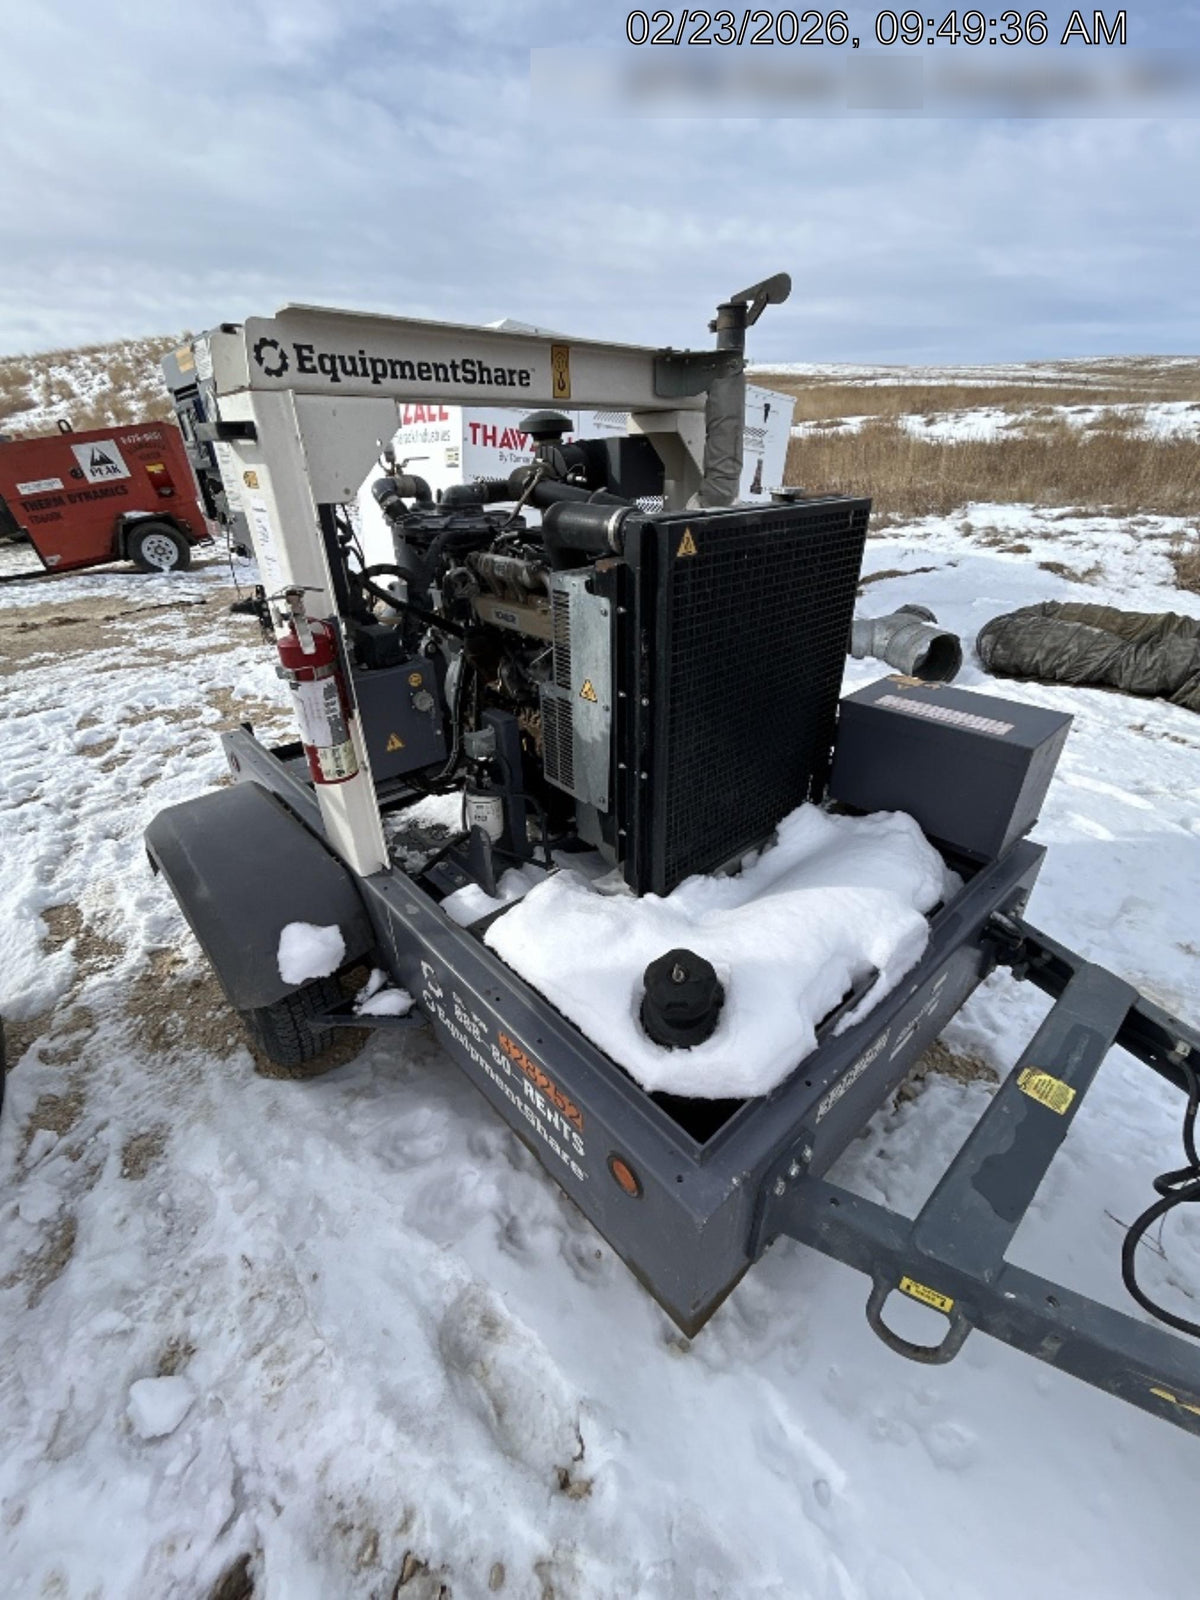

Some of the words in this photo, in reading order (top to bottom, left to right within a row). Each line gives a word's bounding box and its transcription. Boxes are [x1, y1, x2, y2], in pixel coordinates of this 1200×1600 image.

[292, 342, 532, 387] EquipmentShare
[89, 464, 122, 478] PEAK
[21, 495, 66, 512] THERM
[67, 485, 128, 504] DYNAMICS
